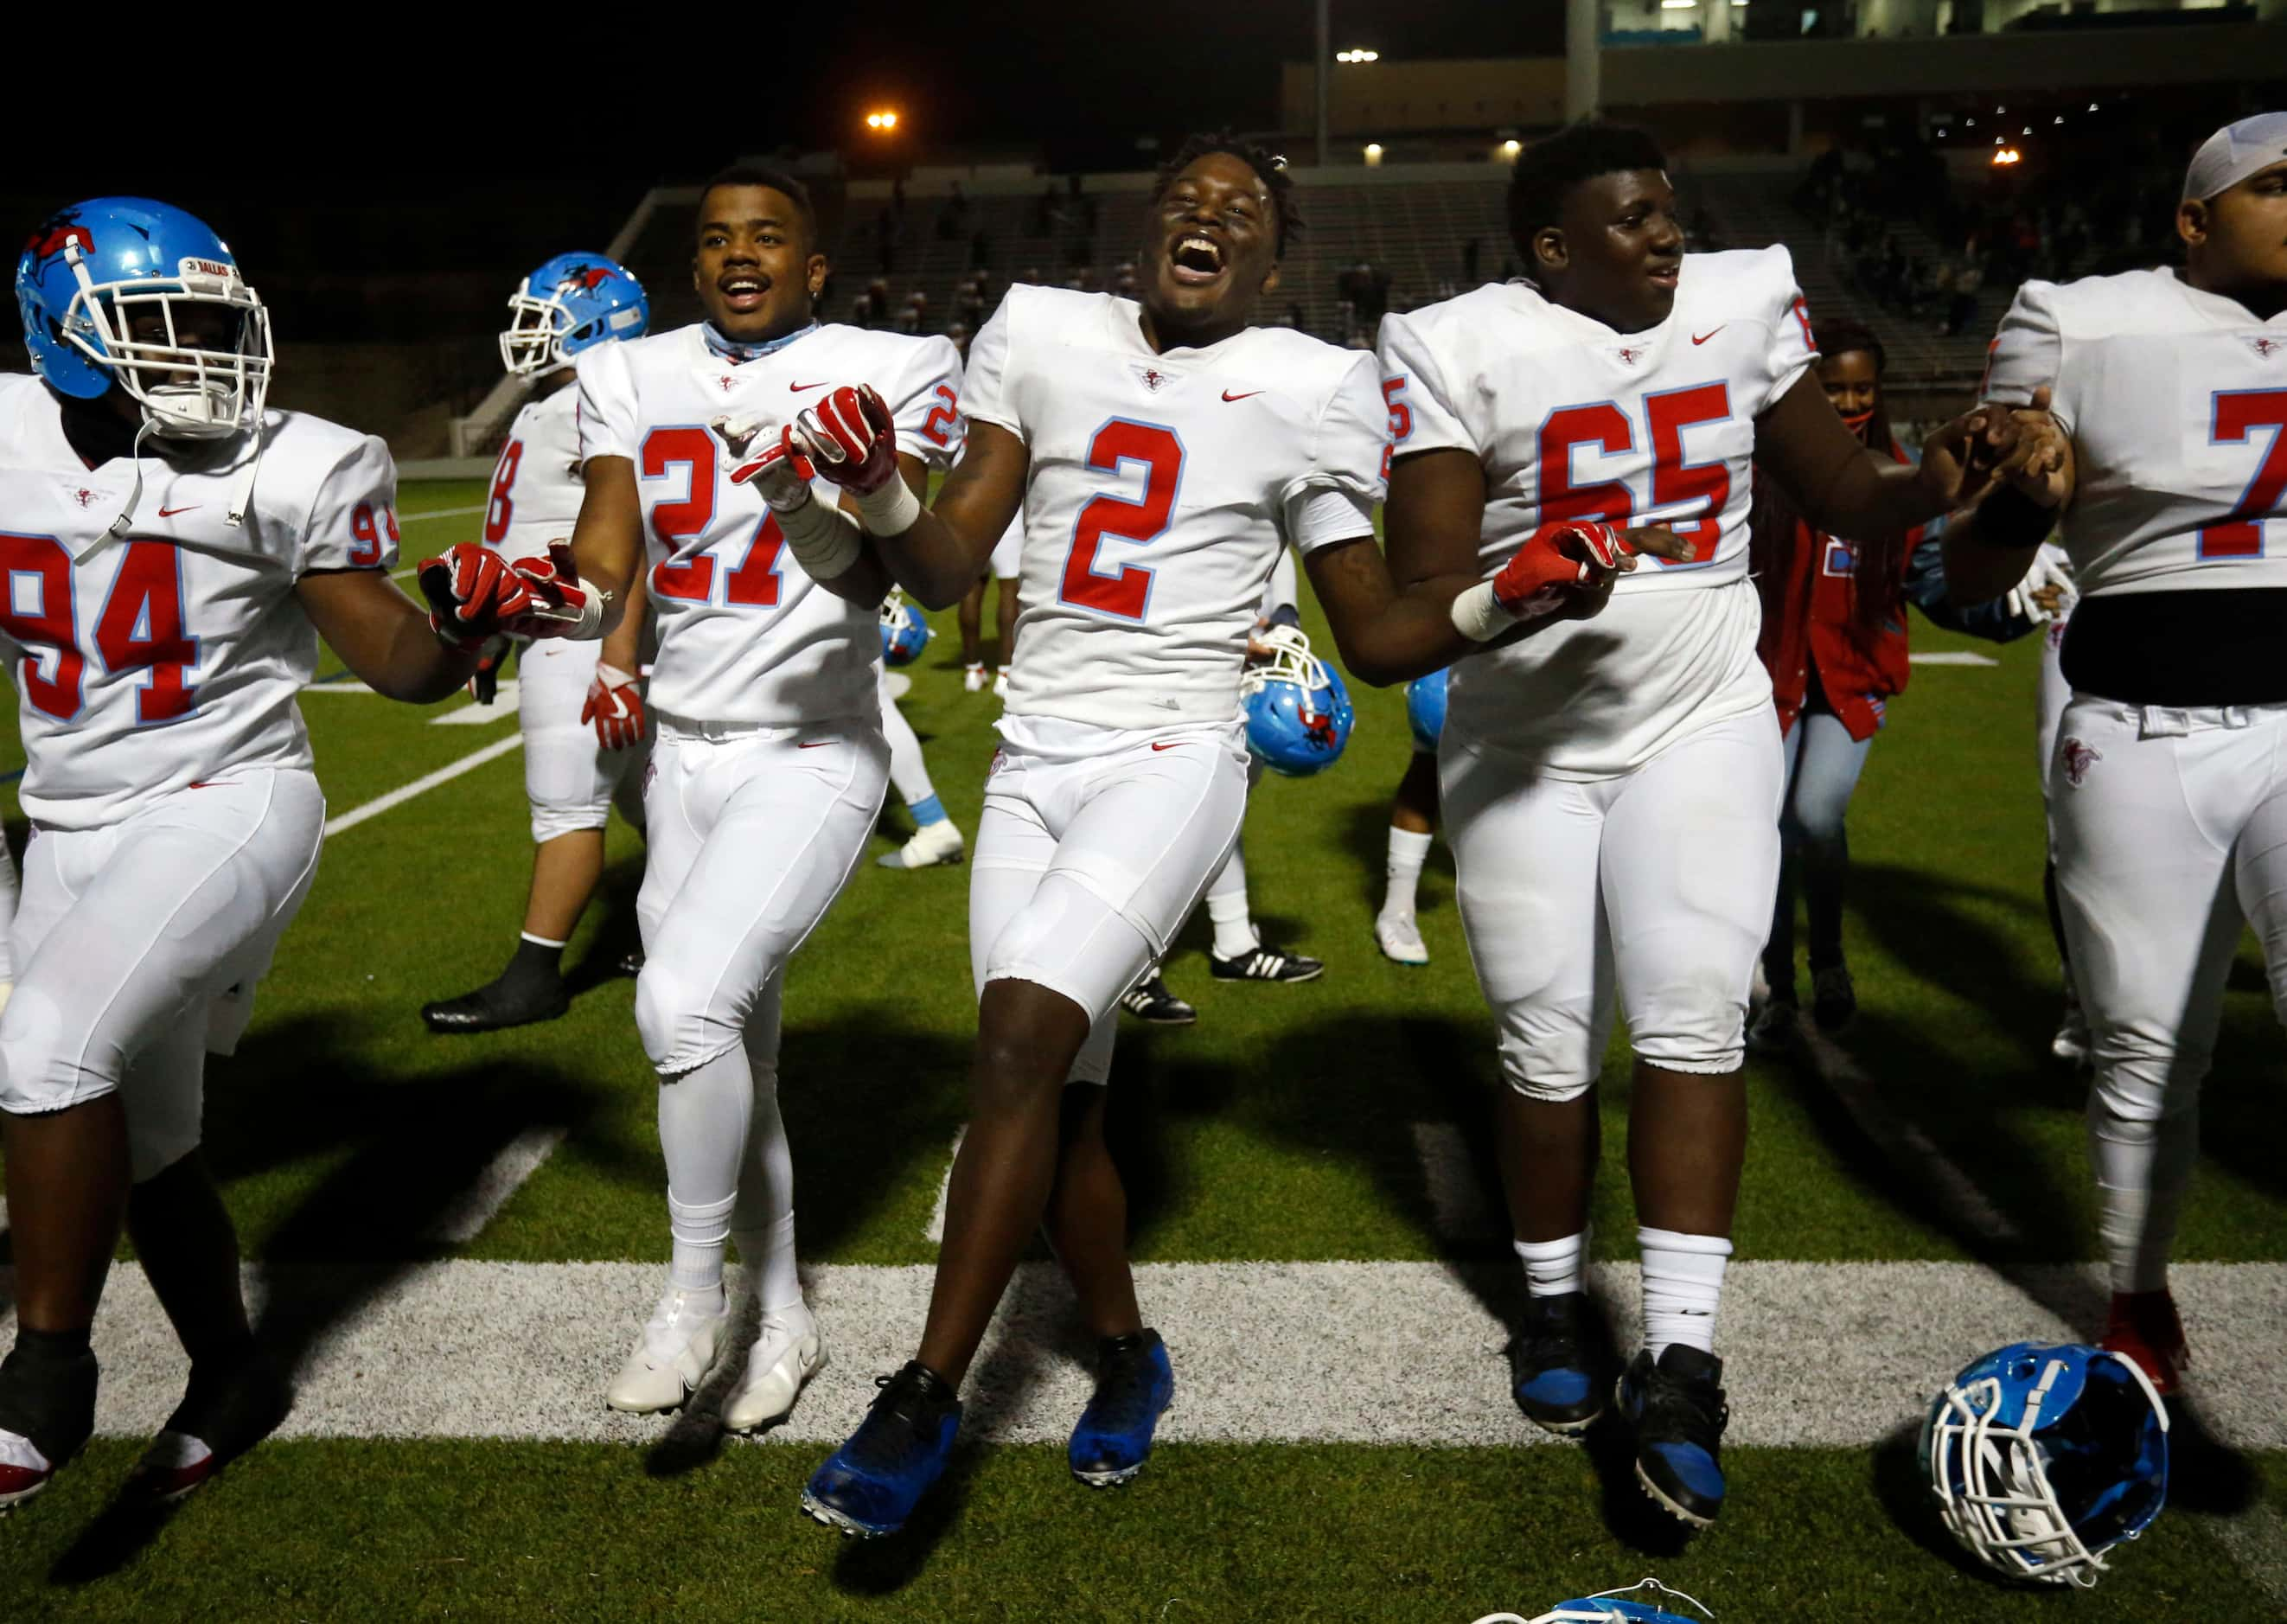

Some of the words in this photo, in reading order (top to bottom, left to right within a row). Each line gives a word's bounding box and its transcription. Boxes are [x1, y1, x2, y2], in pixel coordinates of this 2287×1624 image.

[481, 433, 524, 547] 8
[914, 380, 968, 451] 2
[1536, 379, 1734, 571] 65
[2196, 387, 2287, 561] 7
[1057, 415, 1188, 624] 2
[0, 530, 201, 725] 94
